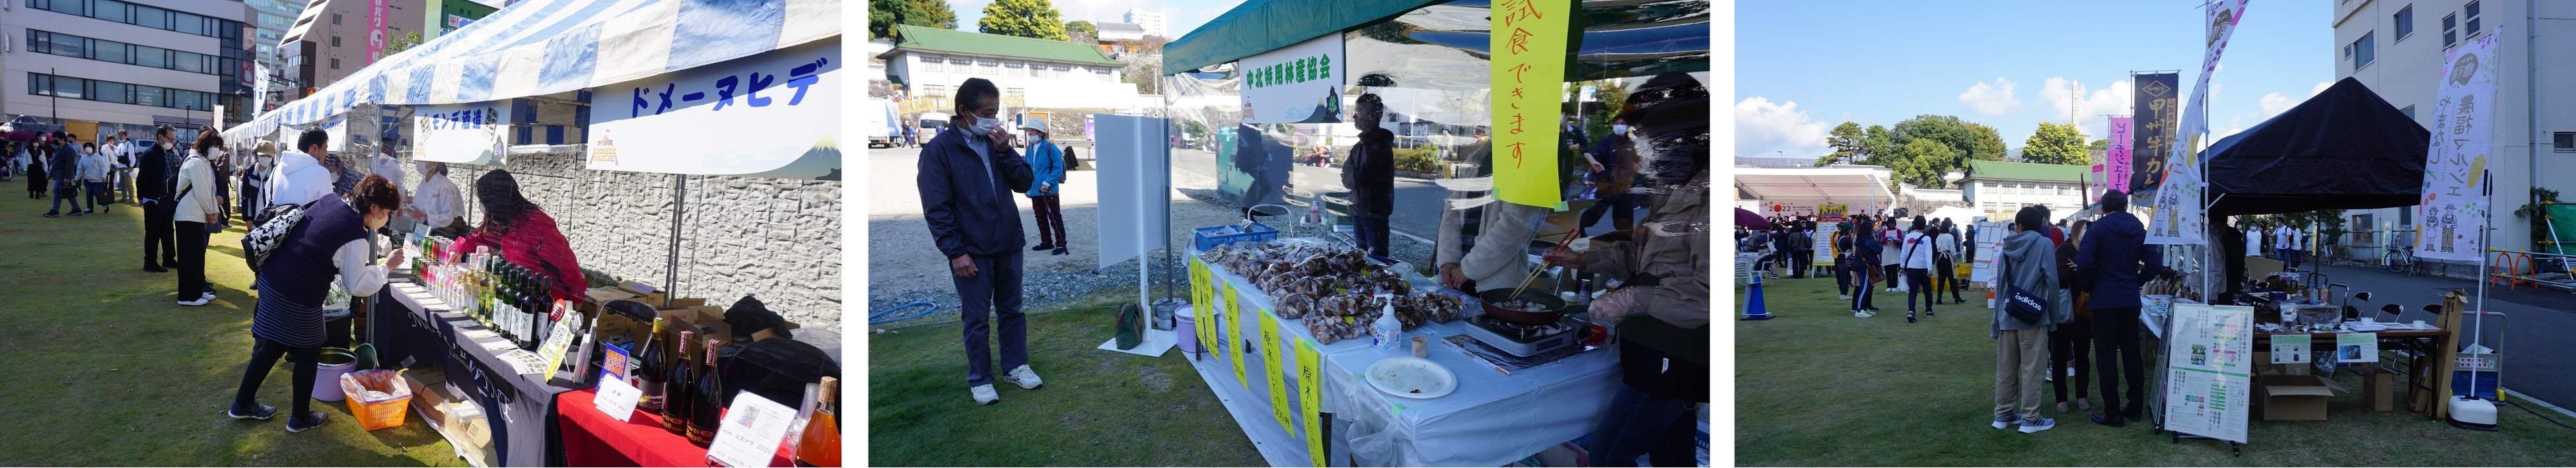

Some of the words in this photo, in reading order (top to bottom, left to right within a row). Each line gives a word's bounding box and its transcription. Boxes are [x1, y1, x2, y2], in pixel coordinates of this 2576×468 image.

[631, 57, 828, 119] ドメーヌヒデ
[1246, 53, 1332, 88] 中北特用林産協会
[1503, 0, 1543, 170] 試食できます
[432, 109, 482, 130] モンデ酒造
[1227, 300, 1238, 358] 原木しいたけ
[2015, 295, 2042, 311] adidas
[1263, 330, 1281, 407] 原木しいたけ
[1303, 365, 1316, 450] 原木しいたけ
[734, 434, 754, 446] ミズナラ
[756, 444, 773, 455] 2020
